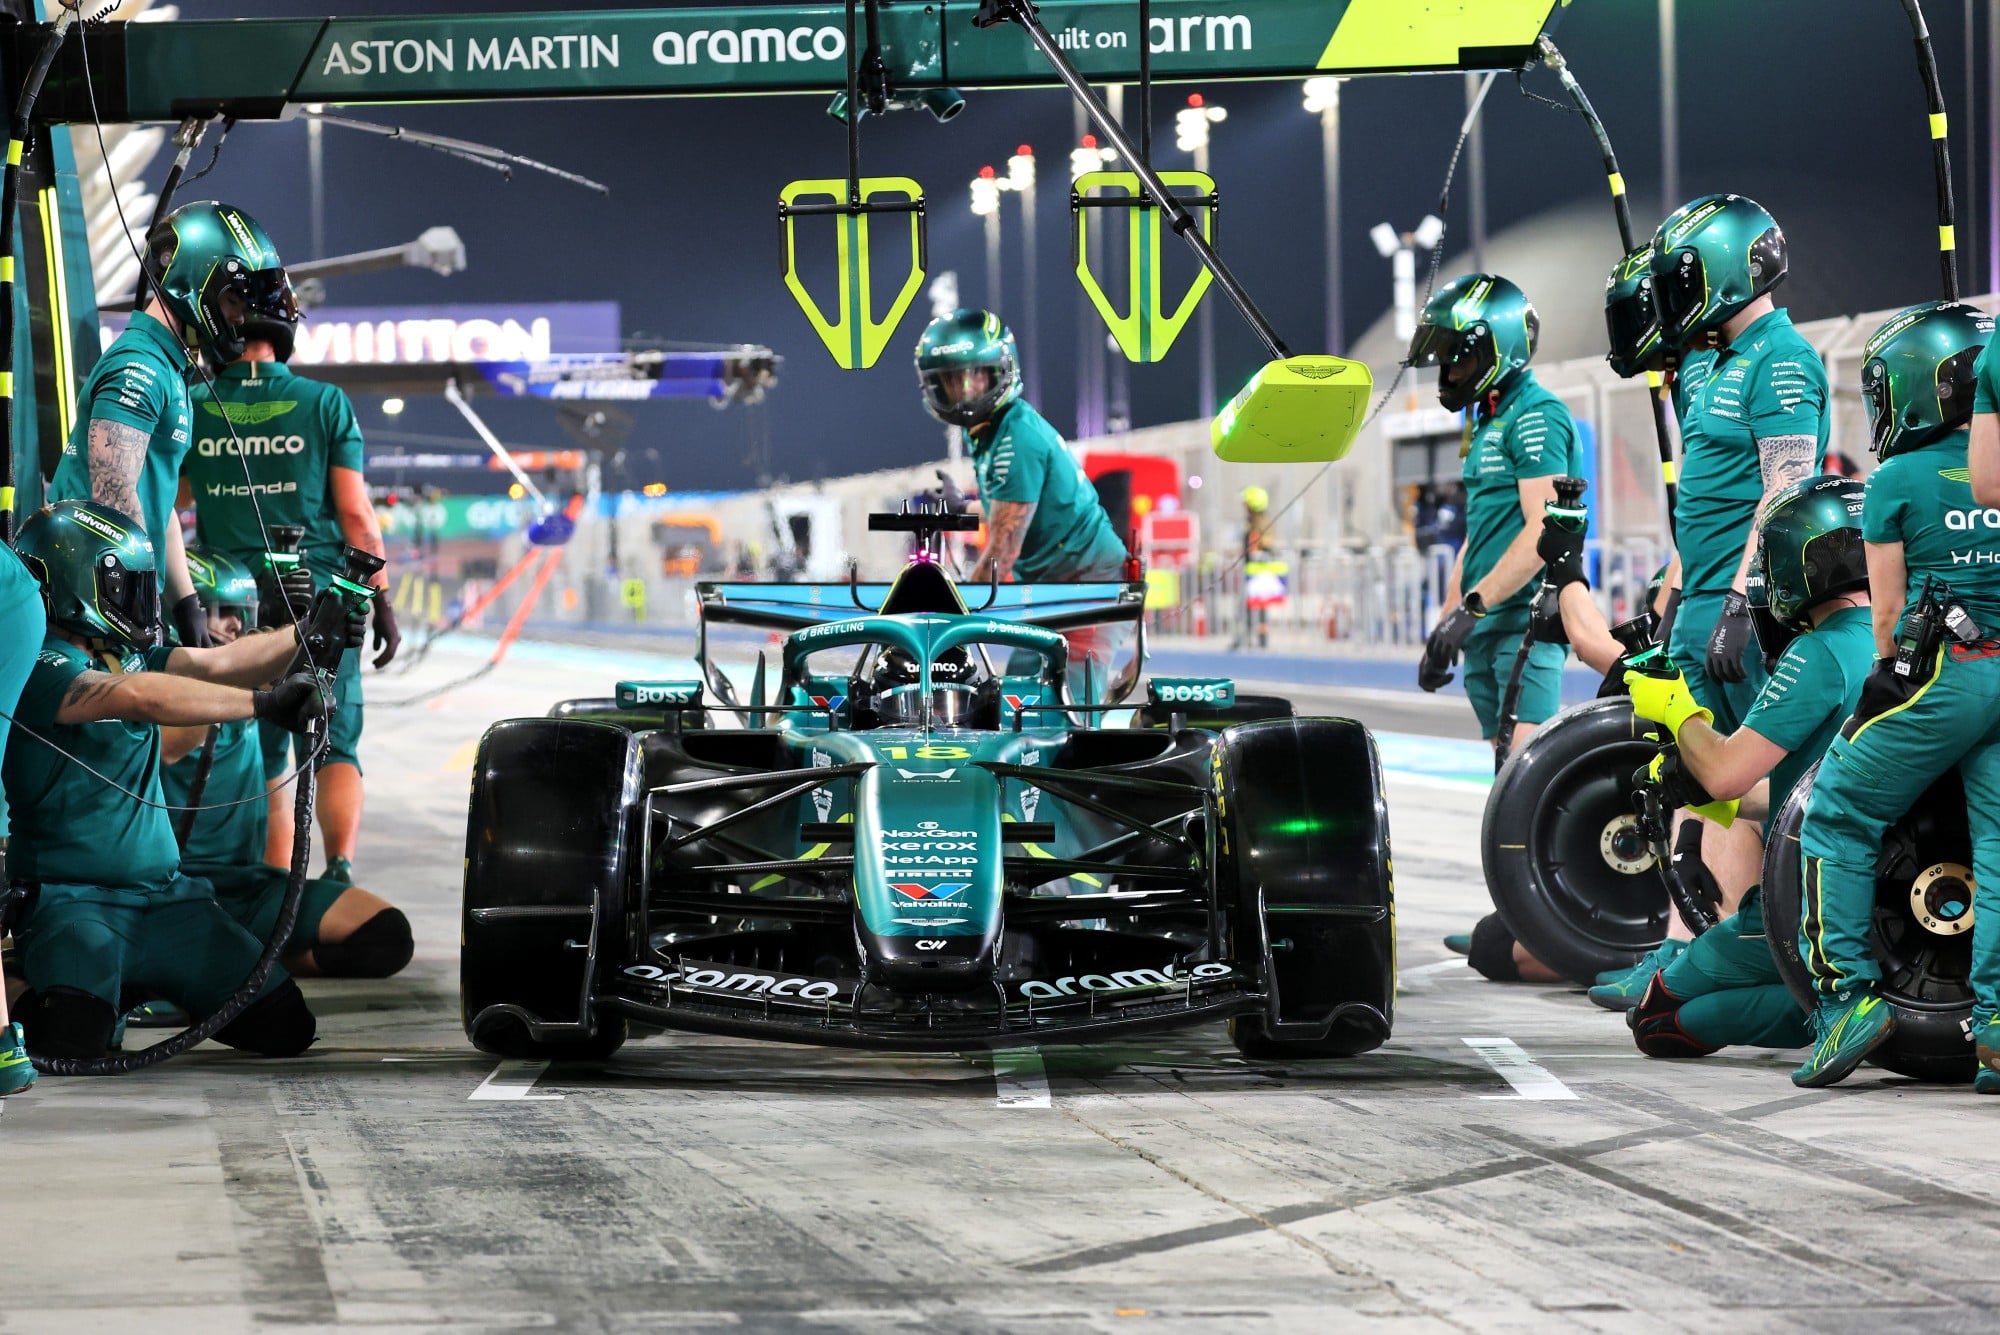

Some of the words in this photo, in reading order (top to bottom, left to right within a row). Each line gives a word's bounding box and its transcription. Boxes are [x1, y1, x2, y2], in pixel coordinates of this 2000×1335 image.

[1034, 27, 1090, 50] uilt
[1095, 31, 1127, 49] on
[1149, 14, 1252, 54] arm
[322, 39, 453, 75] ASTON
[467, 34, 619, 72] MARTIN
[652, 26, 846, 65] aramco
[1671, 204, 1717, 239] Valvoline
[1867, 315, 1916, 352] Valvoline
[198, 434, 305, 457] aramco
[222, 481, 297, 496] Honda
[73, 509, 124, 542] Valvoline
[104, 610, 118, 623] ASTON
[116, 620, 131, 635] MARTIN
[809, 621, 865, 637] BREITLING
[906, 661, 958, 674] armco
[636, 687, 689, 704] BOSS
[1161, 684, 1215, 702] BOSS
[880, 746, 972, 759] 18
[879, 829, 977, 838] NexGen
[881, 841, 977, 851] xerox
[879, 855, 978, 865] NetApp
[884, 869, 973, 877] PIRELLI
[890, 900, 969, 908] Valvoline
[623, 965, 839, 999] aramco
[1019, 963, 1233, 999] aramco
